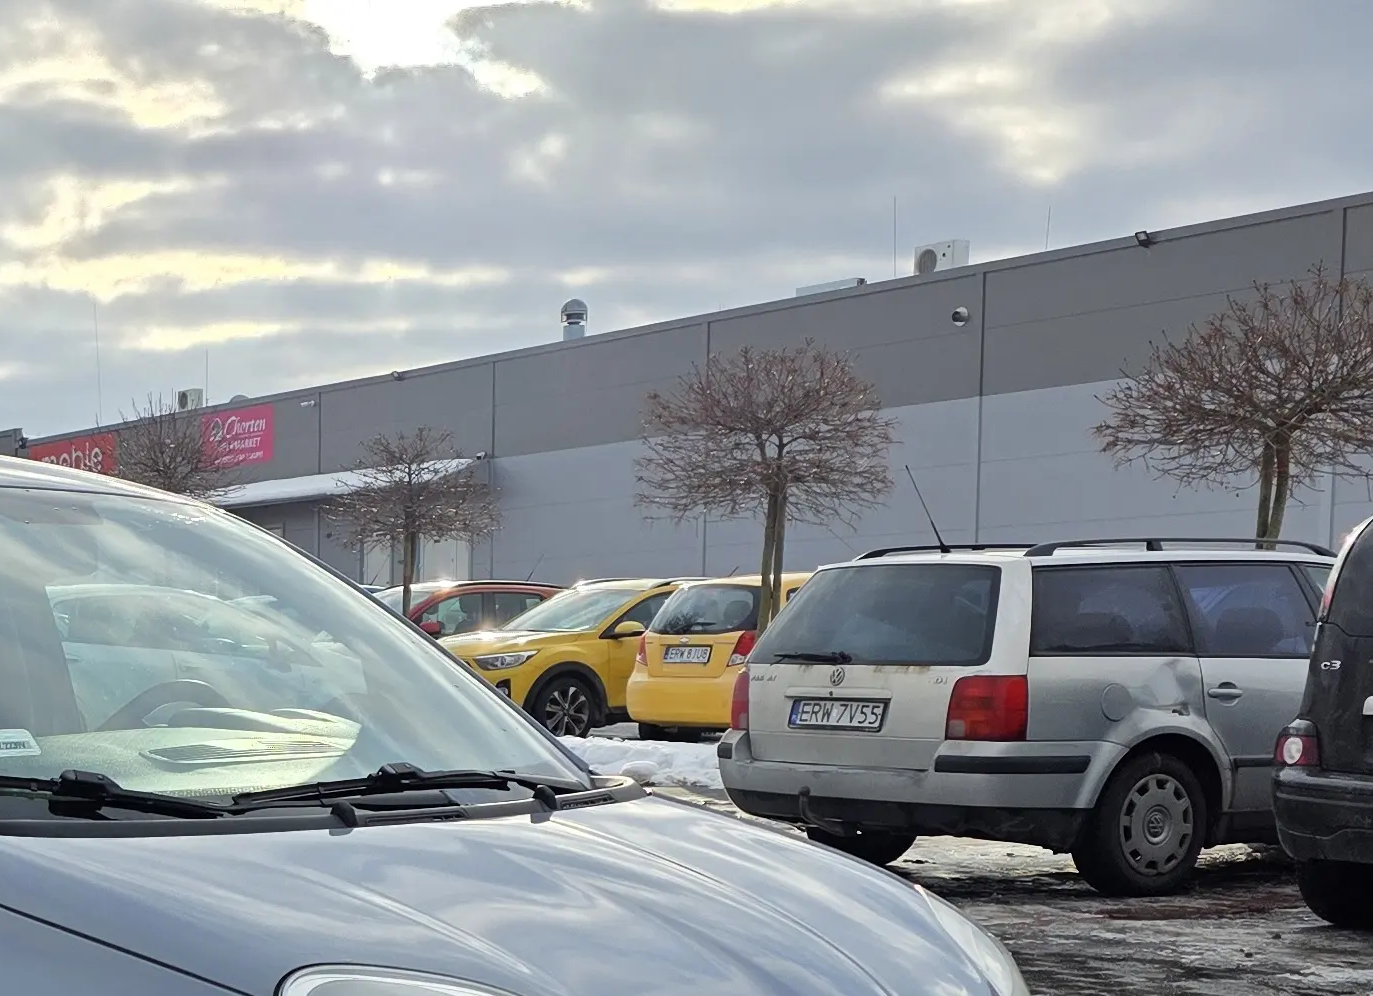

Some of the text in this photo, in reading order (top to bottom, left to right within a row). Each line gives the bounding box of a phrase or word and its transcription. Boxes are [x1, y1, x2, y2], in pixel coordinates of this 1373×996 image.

[1320, 660, 1342, 670] C3
[799, 702, 881, 725] ERW 7V55
